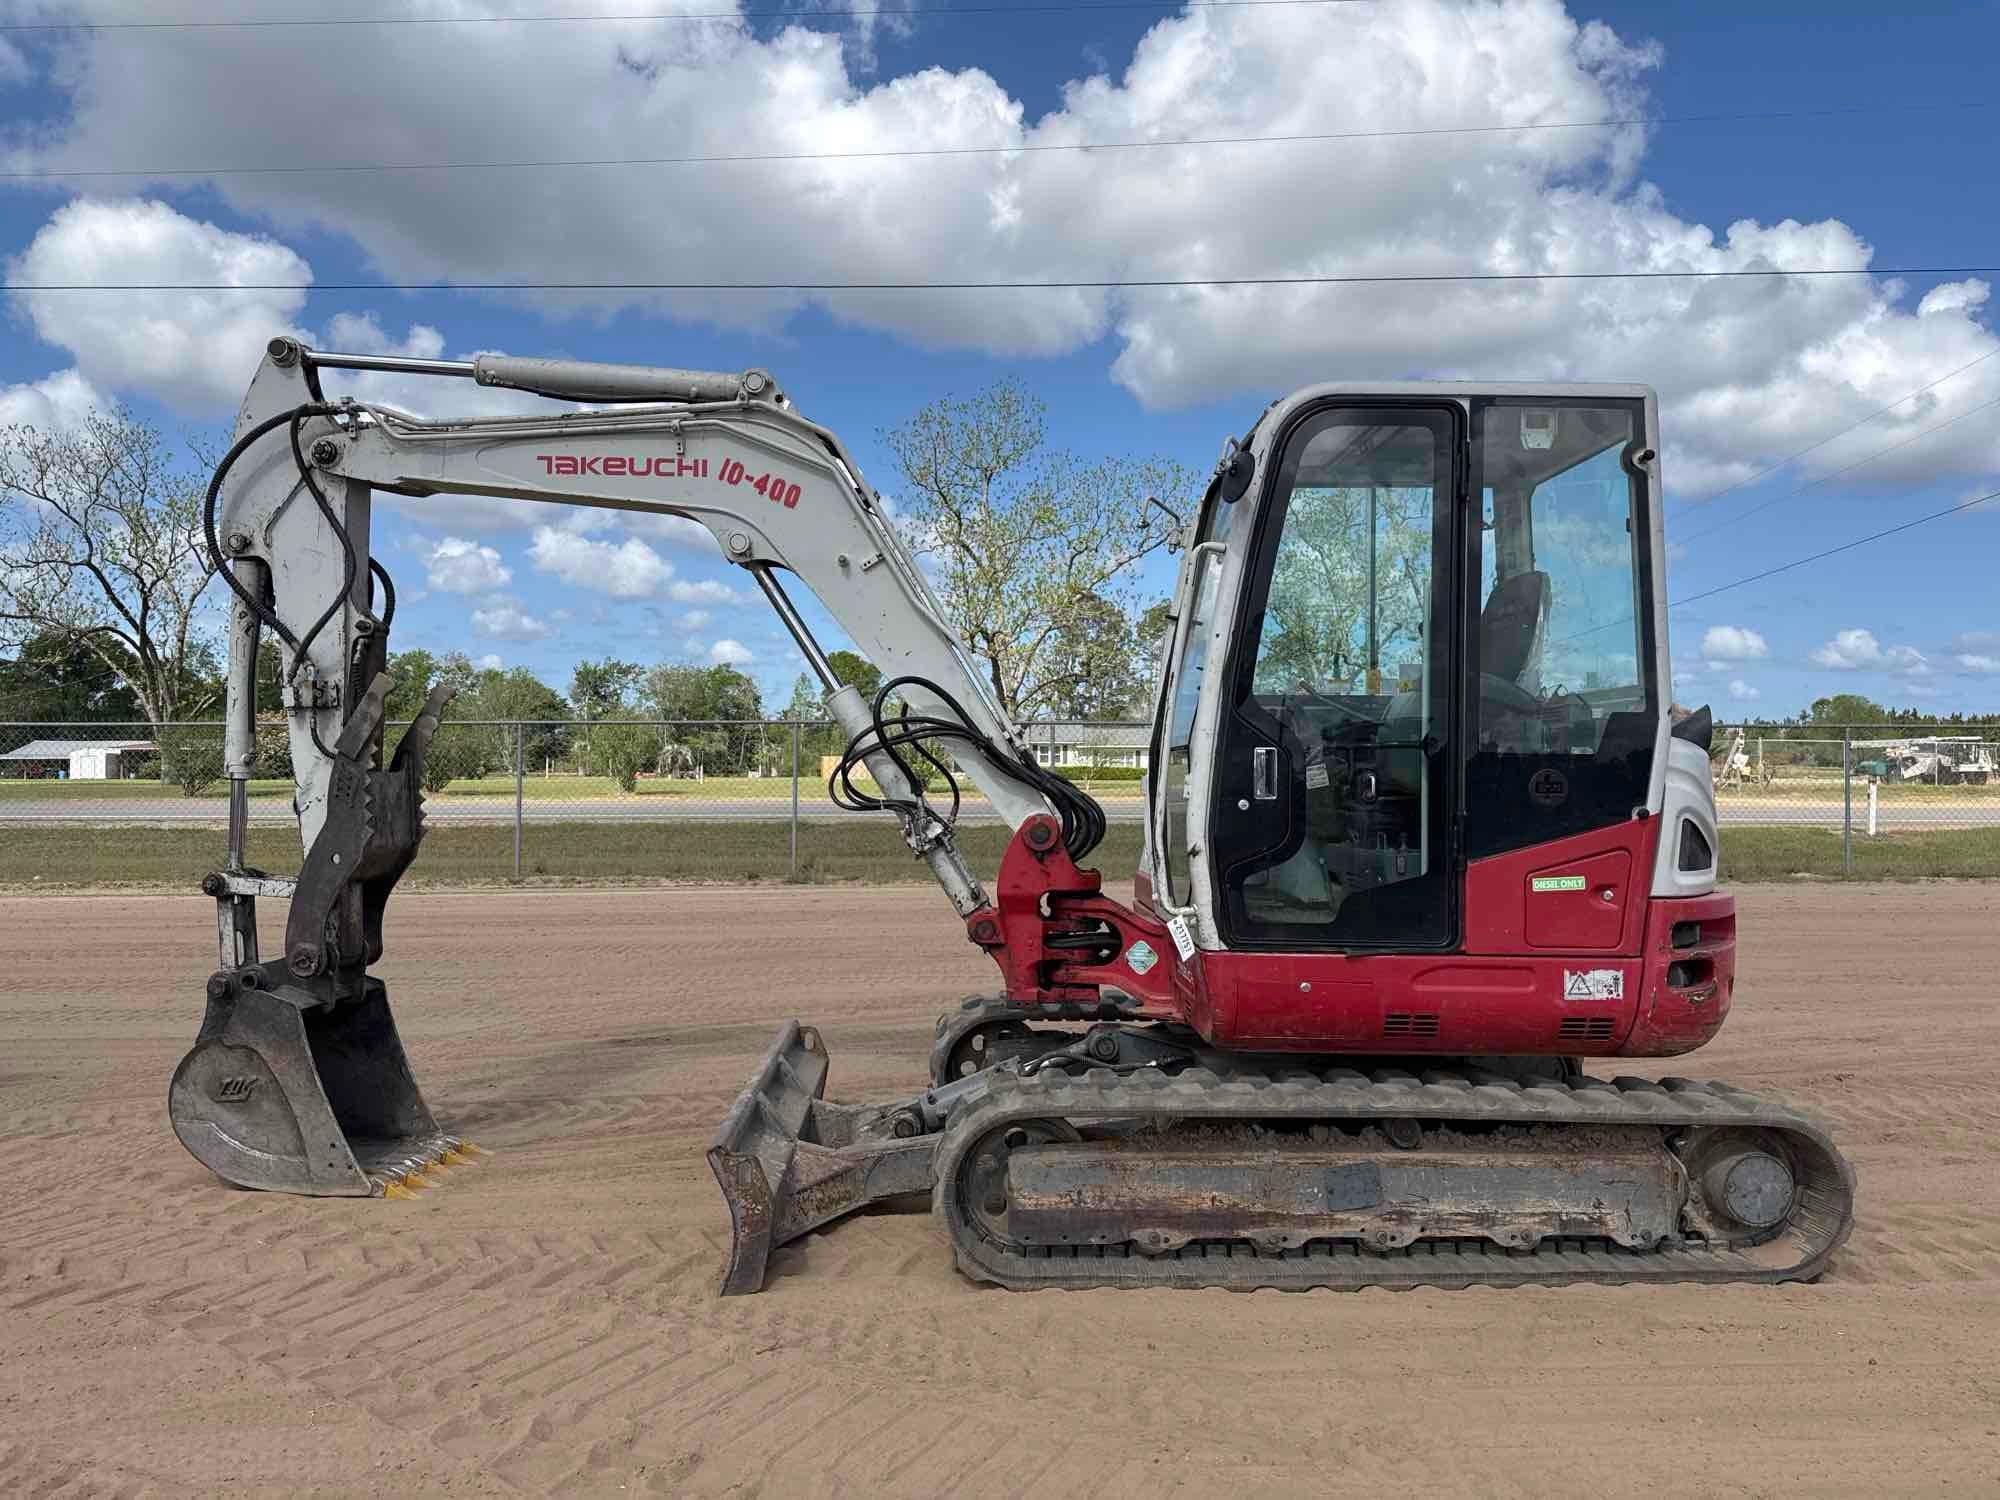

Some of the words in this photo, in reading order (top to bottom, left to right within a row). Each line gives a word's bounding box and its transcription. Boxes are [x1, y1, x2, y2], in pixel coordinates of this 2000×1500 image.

[536, 455, 708, 478] TAKEUCHI
[717, 457, 802, 510] 10-400
[1534, 880, 1560, 889] DIESEL
[1560, 879, 1583, 888] ONLY
